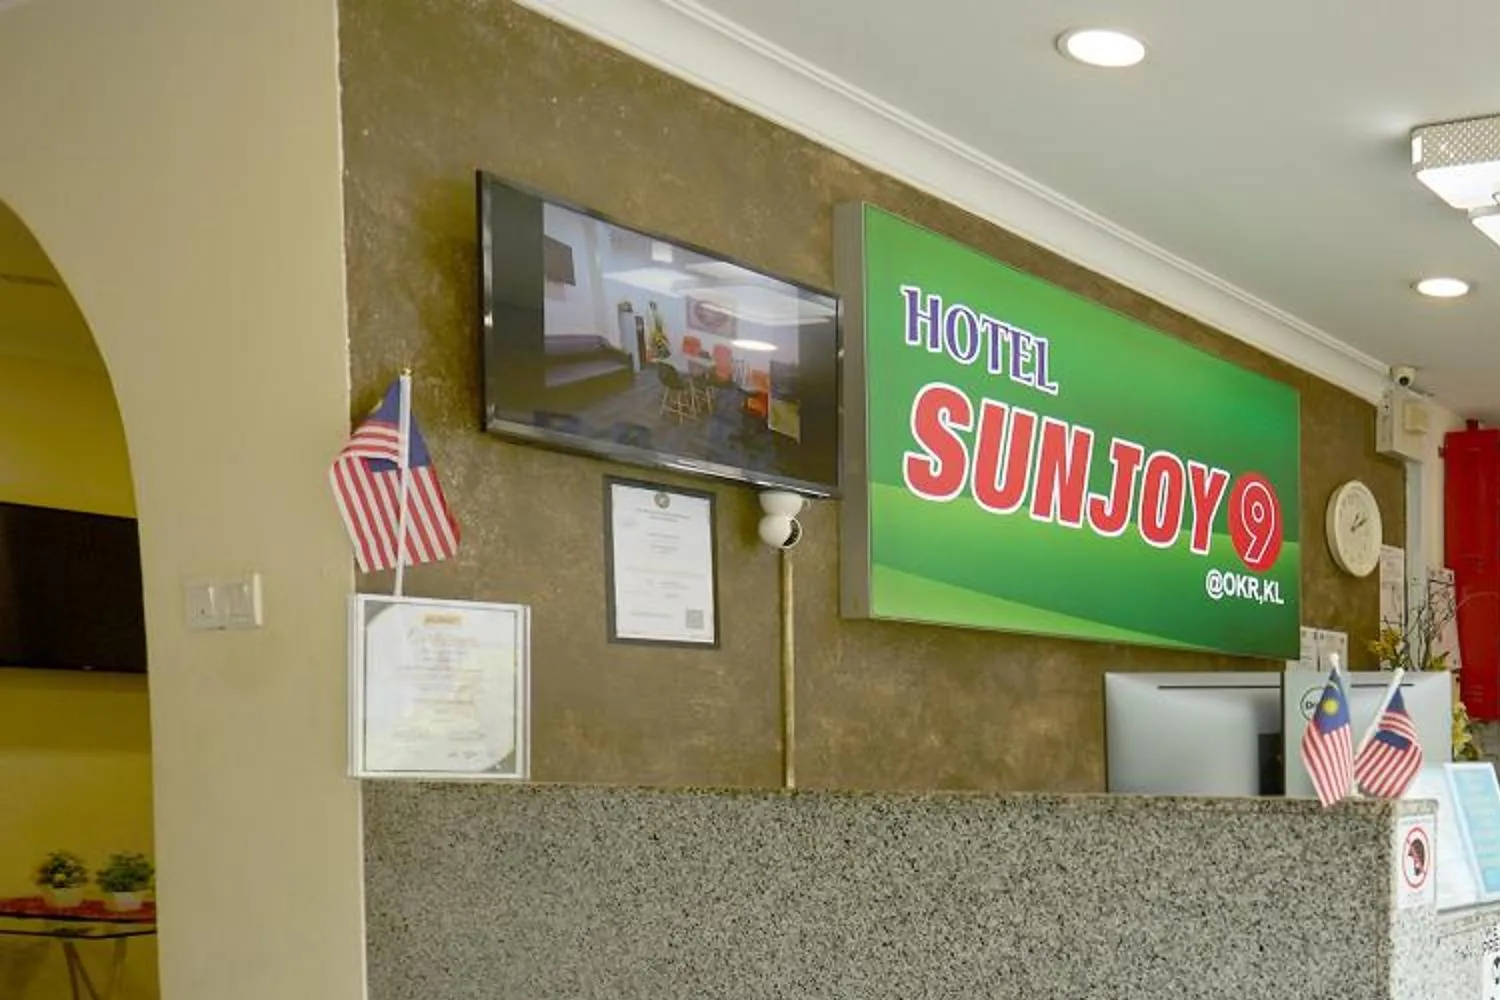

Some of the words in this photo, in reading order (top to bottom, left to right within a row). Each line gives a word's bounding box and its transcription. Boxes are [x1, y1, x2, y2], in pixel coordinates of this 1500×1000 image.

[901, 285, 1059, 395] HOTEL
[903, 382, 1229, 554] SUNJOY
[1240, 480, 1276, 564] 9
[1205, 569, 1285, 605] @OKR,KL
